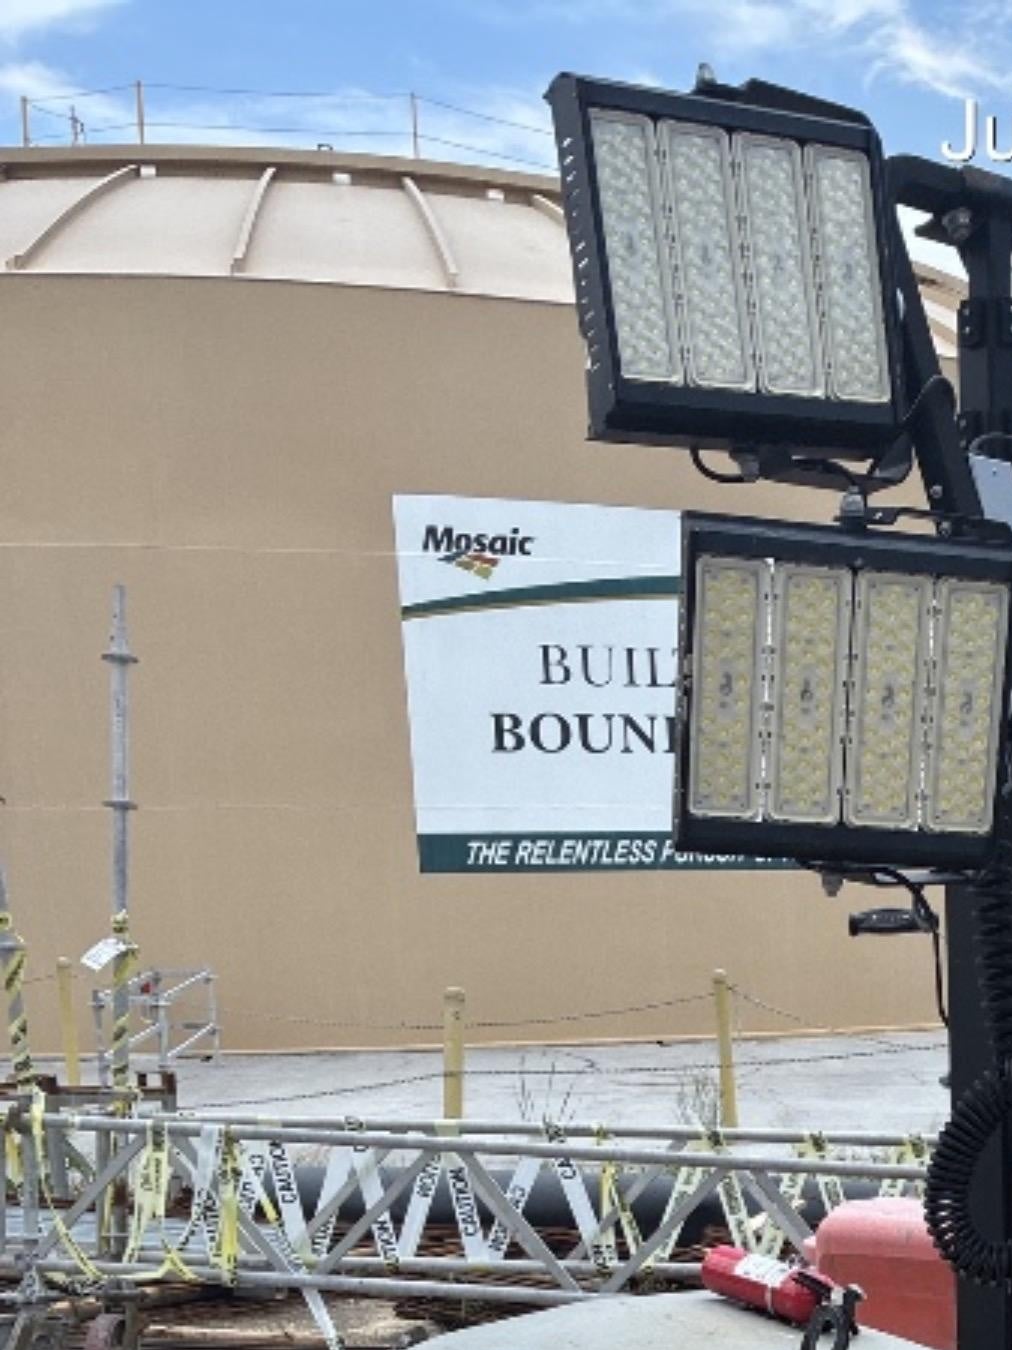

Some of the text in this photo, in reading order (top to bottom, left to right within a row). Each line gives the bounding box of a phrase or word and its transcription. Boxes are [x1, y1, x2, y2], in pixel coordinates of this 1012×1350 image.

[422, 524, 537, 556] Mosaic
[538, 644, 677, 687] BUIL
[466, 840, 511, 865] THE
[515, 839, 657, 865] RELENTLESS
[449, 1166, 478, 1237] CAUTION
